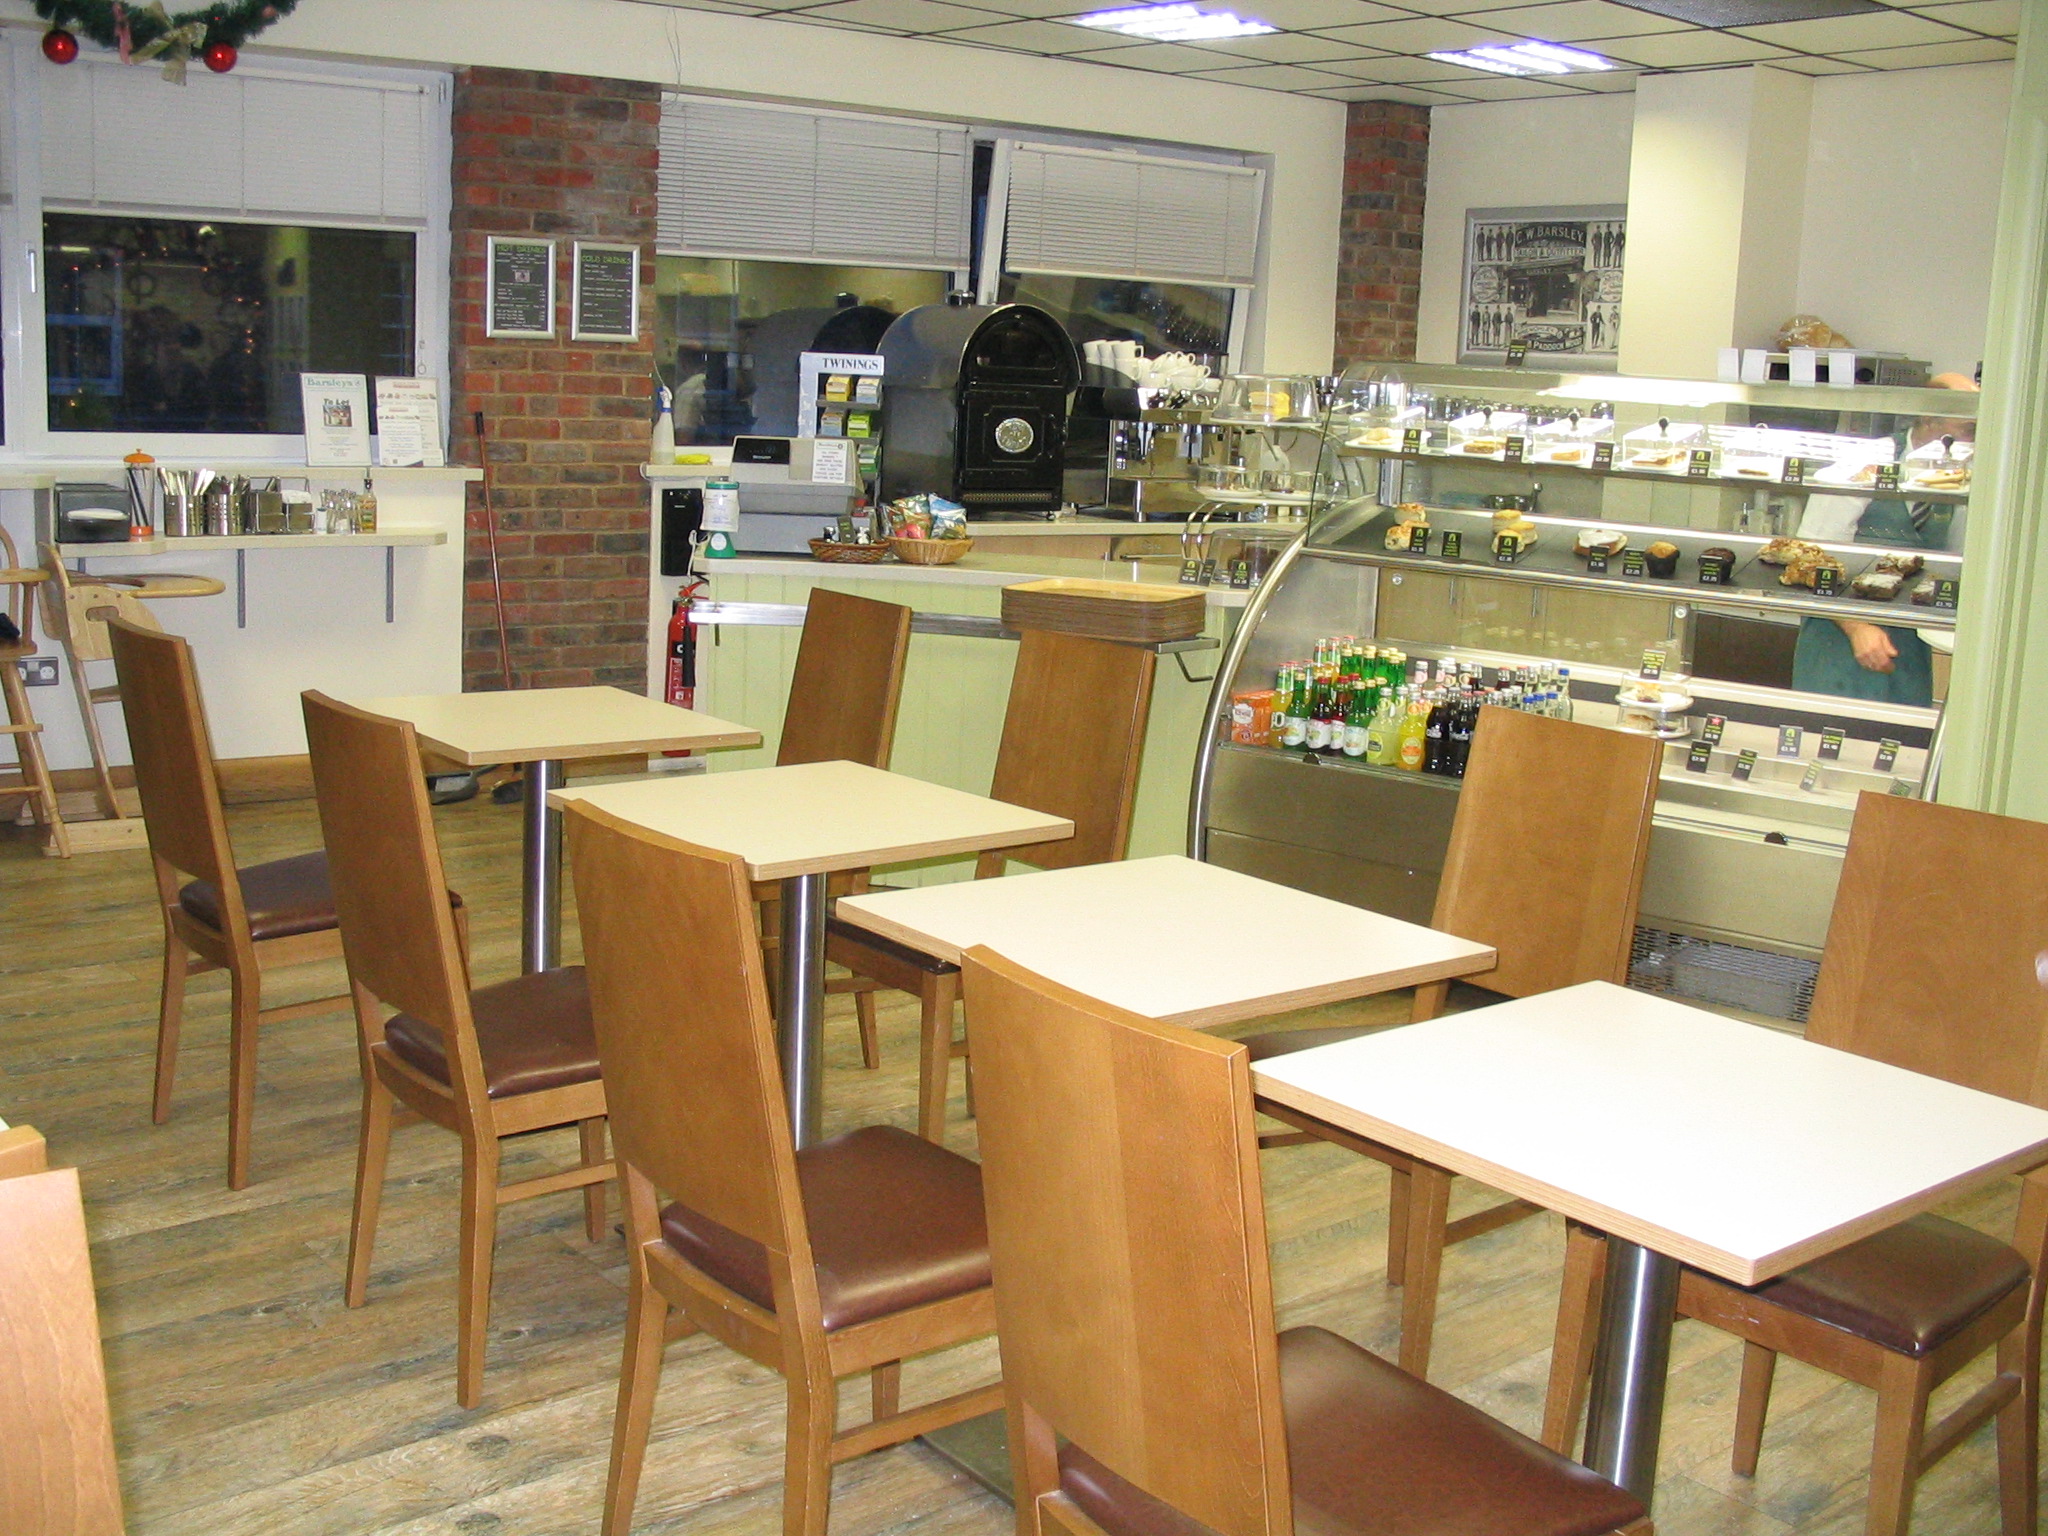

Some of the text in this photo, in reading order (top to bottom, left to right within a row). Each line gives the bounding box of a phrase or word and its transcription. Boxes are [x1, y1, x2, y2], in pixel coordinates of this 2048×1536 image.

[603, 256, 632, 264] DRINKS
[822, 357, 879, 370] TWININGS
[307, 378, 353, 388] Barsleys
[323, 398, 350, 406] To Let
